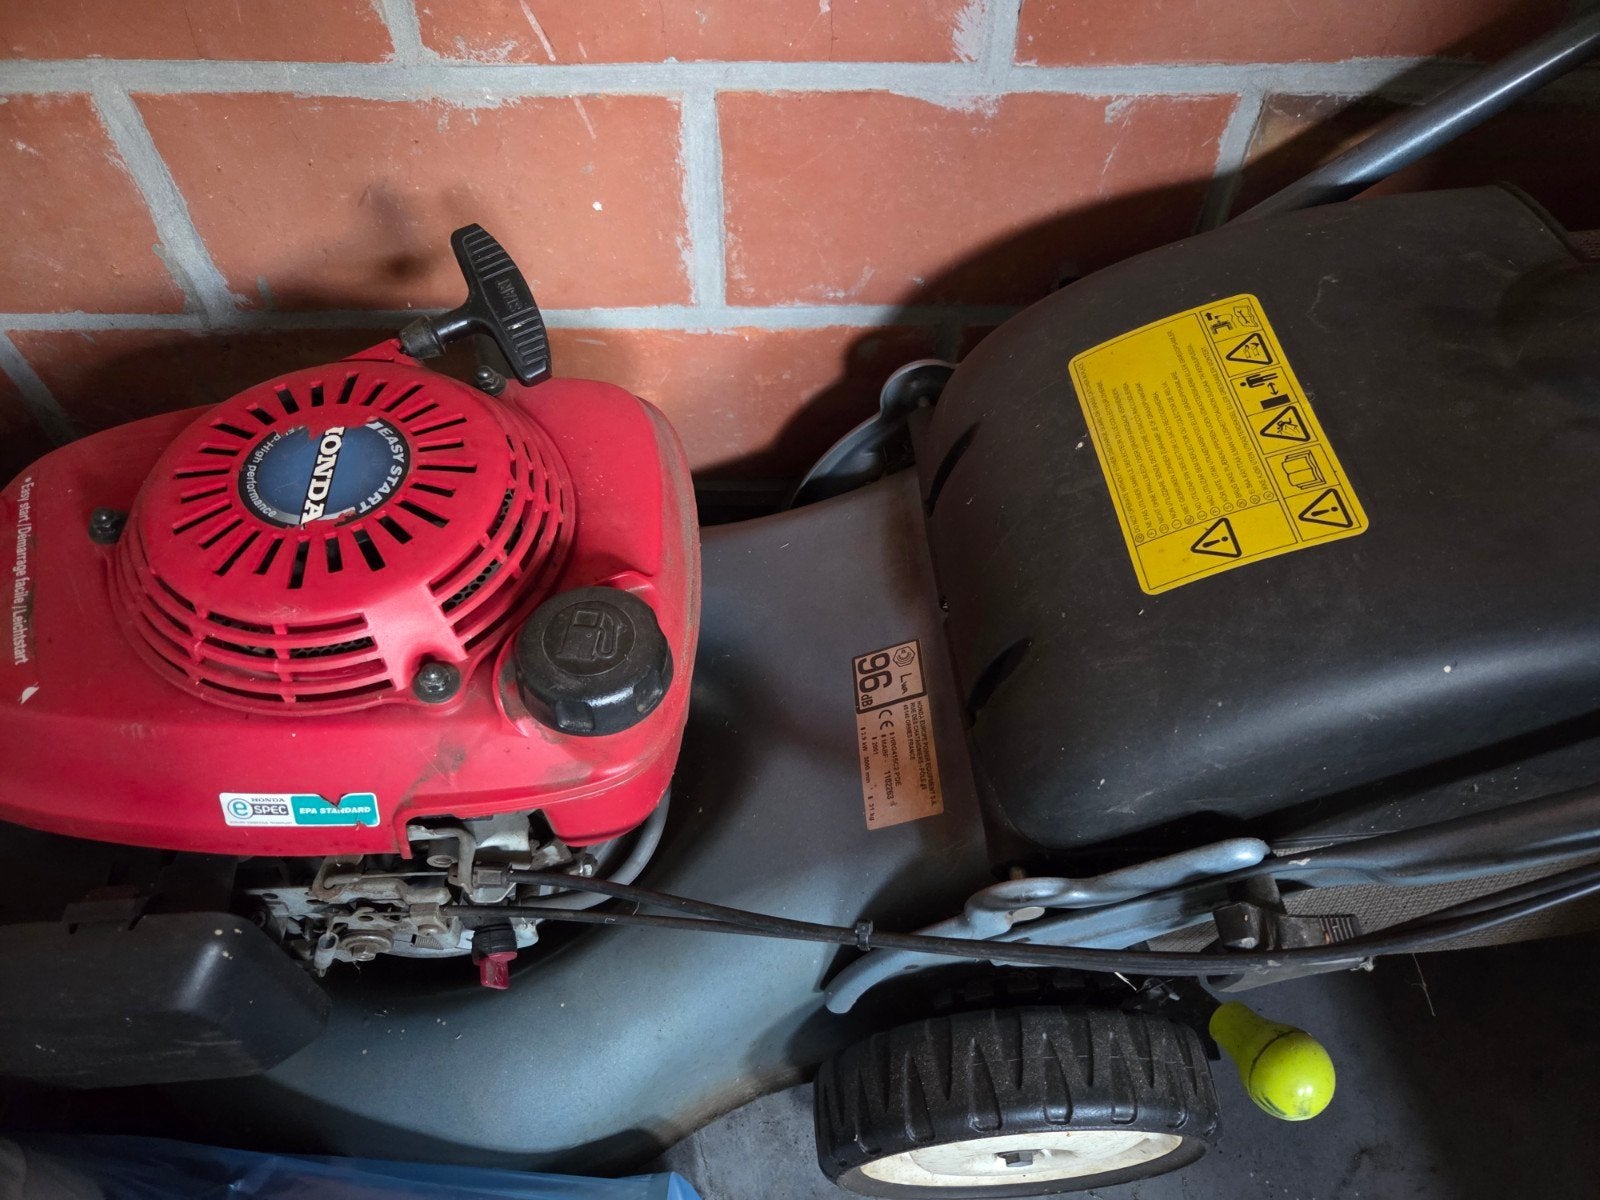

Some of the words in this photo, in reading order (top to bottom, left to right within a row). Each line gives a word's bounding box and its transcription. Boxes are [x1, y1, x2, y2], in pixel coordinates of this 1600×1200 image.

[377, 422, 404, 463] EASY
[246, 464, 278, 518] performance
[358, 464, 403, 514] START
[856, 651, 892, 694] 96
[860, 692, 872, 707] dB
[254, 805, 288, 815] SPEC
[320, 806, 371, 814] STANDARD
